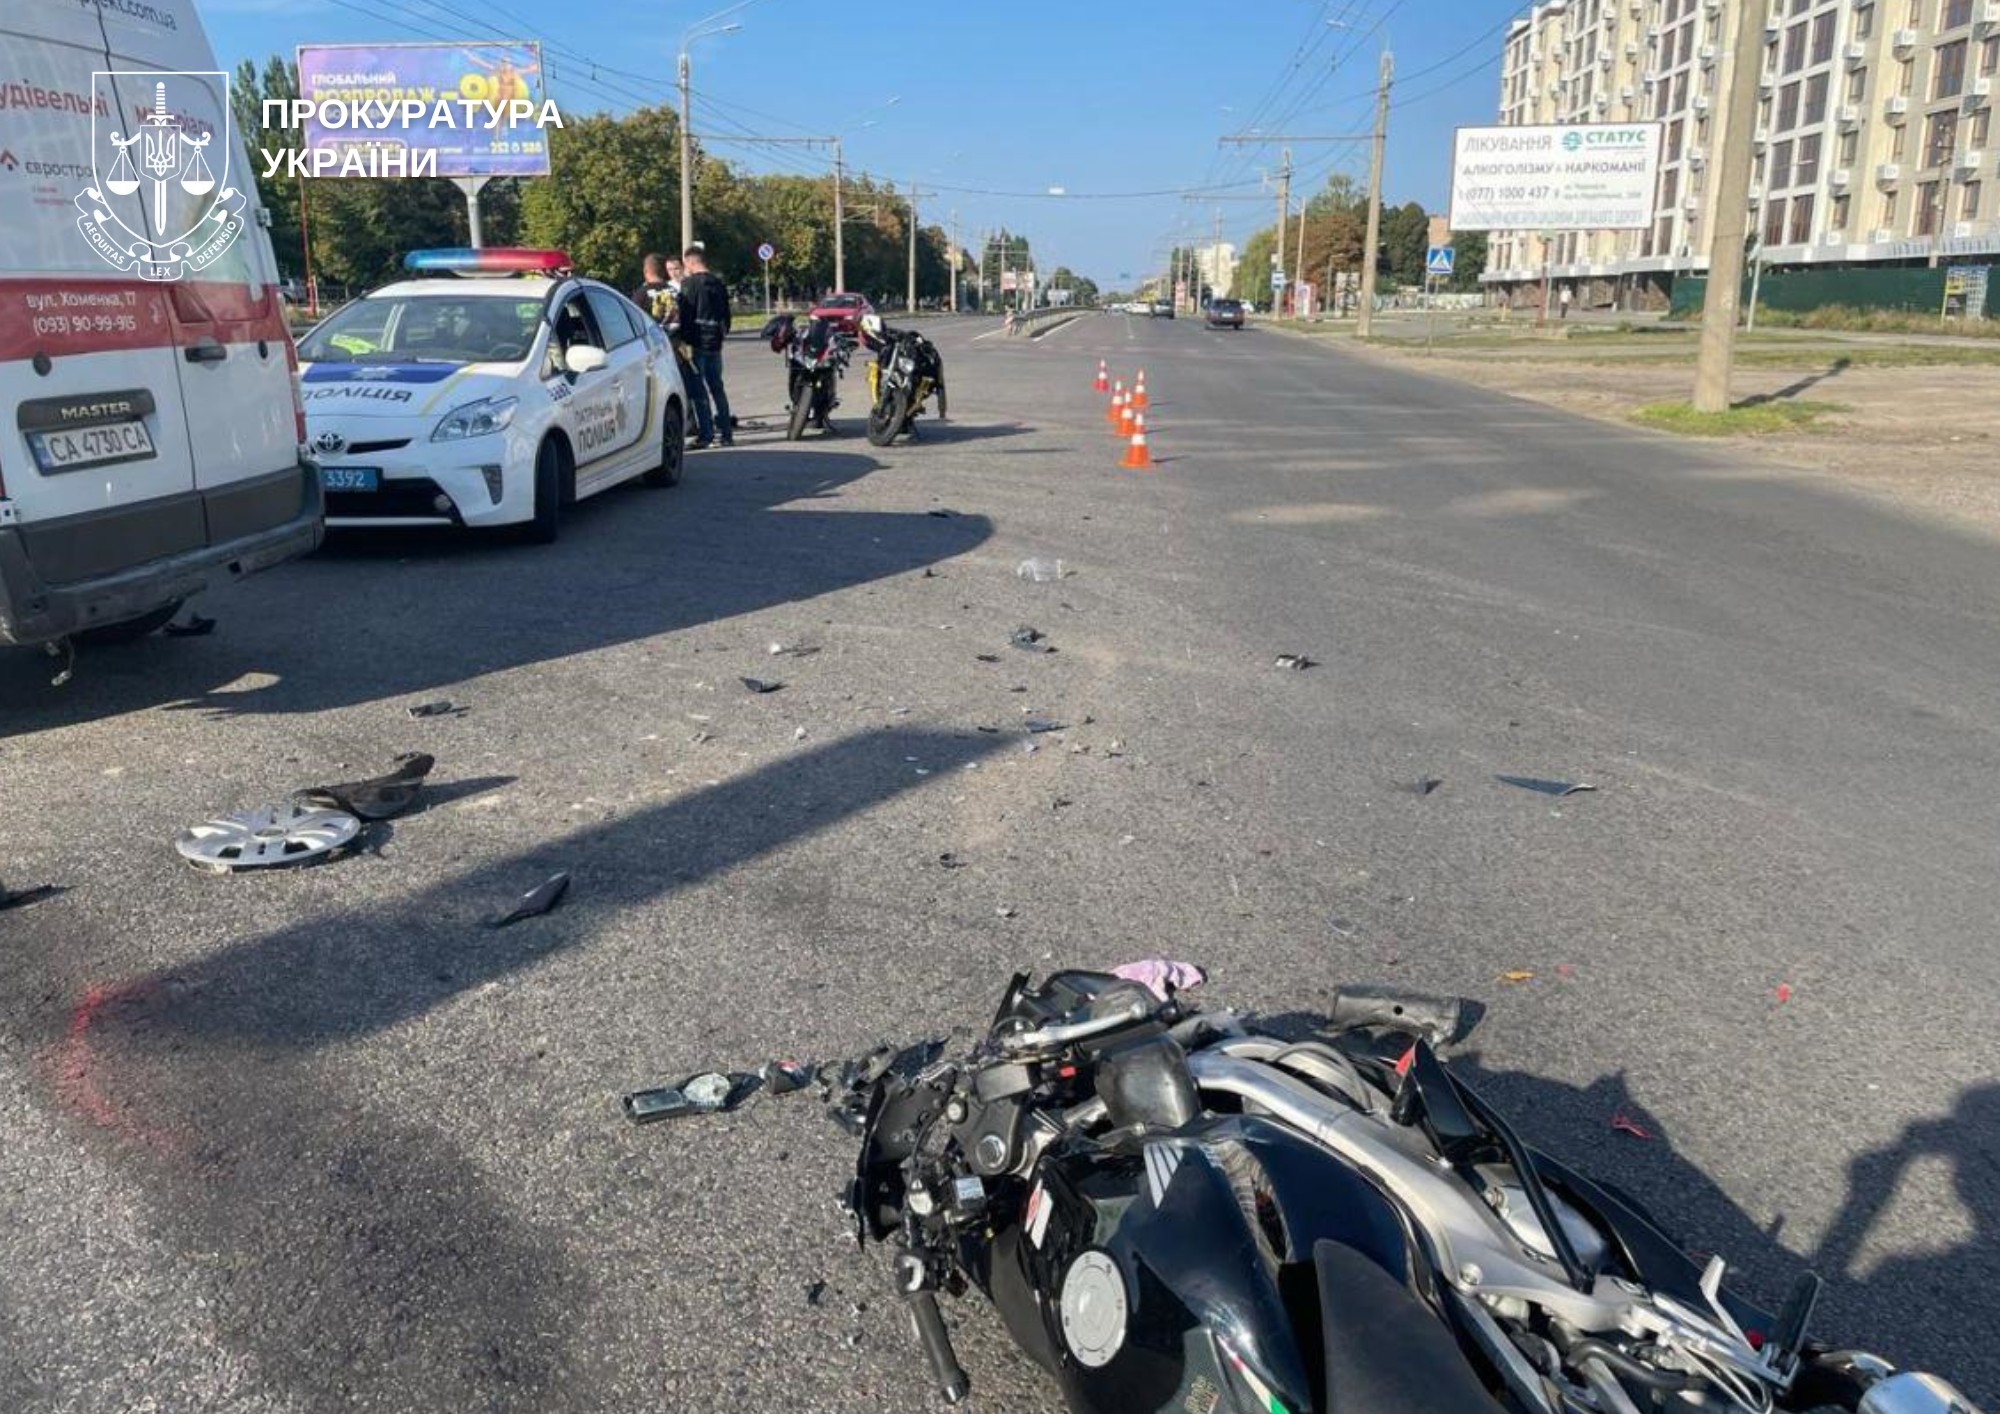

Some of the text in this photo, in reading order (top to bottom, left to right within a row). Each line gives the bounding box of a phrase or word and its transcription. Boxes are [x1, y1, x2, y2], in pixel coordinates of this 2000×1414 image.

[1464, 135, 1552, 154] ЛІКУВАННЯ
[1585, 129, 1646, 144] СТАТУС
[1463, 163, 1553, 176] АЛКОГОЛІЗМУ
[1565, 158, 1646, 174] НАРКОМАНІЇ
[26, 293, 57, 311] вул.
[33, 316, 70, 336] (093)
[61, 401, 131, 419] MASTER
[50, 437, 80, 461] CA
[83, 429, 122, 455] 4730
[123, 424, 147, 449] CA
[325, 470, 366, 486] 3392
